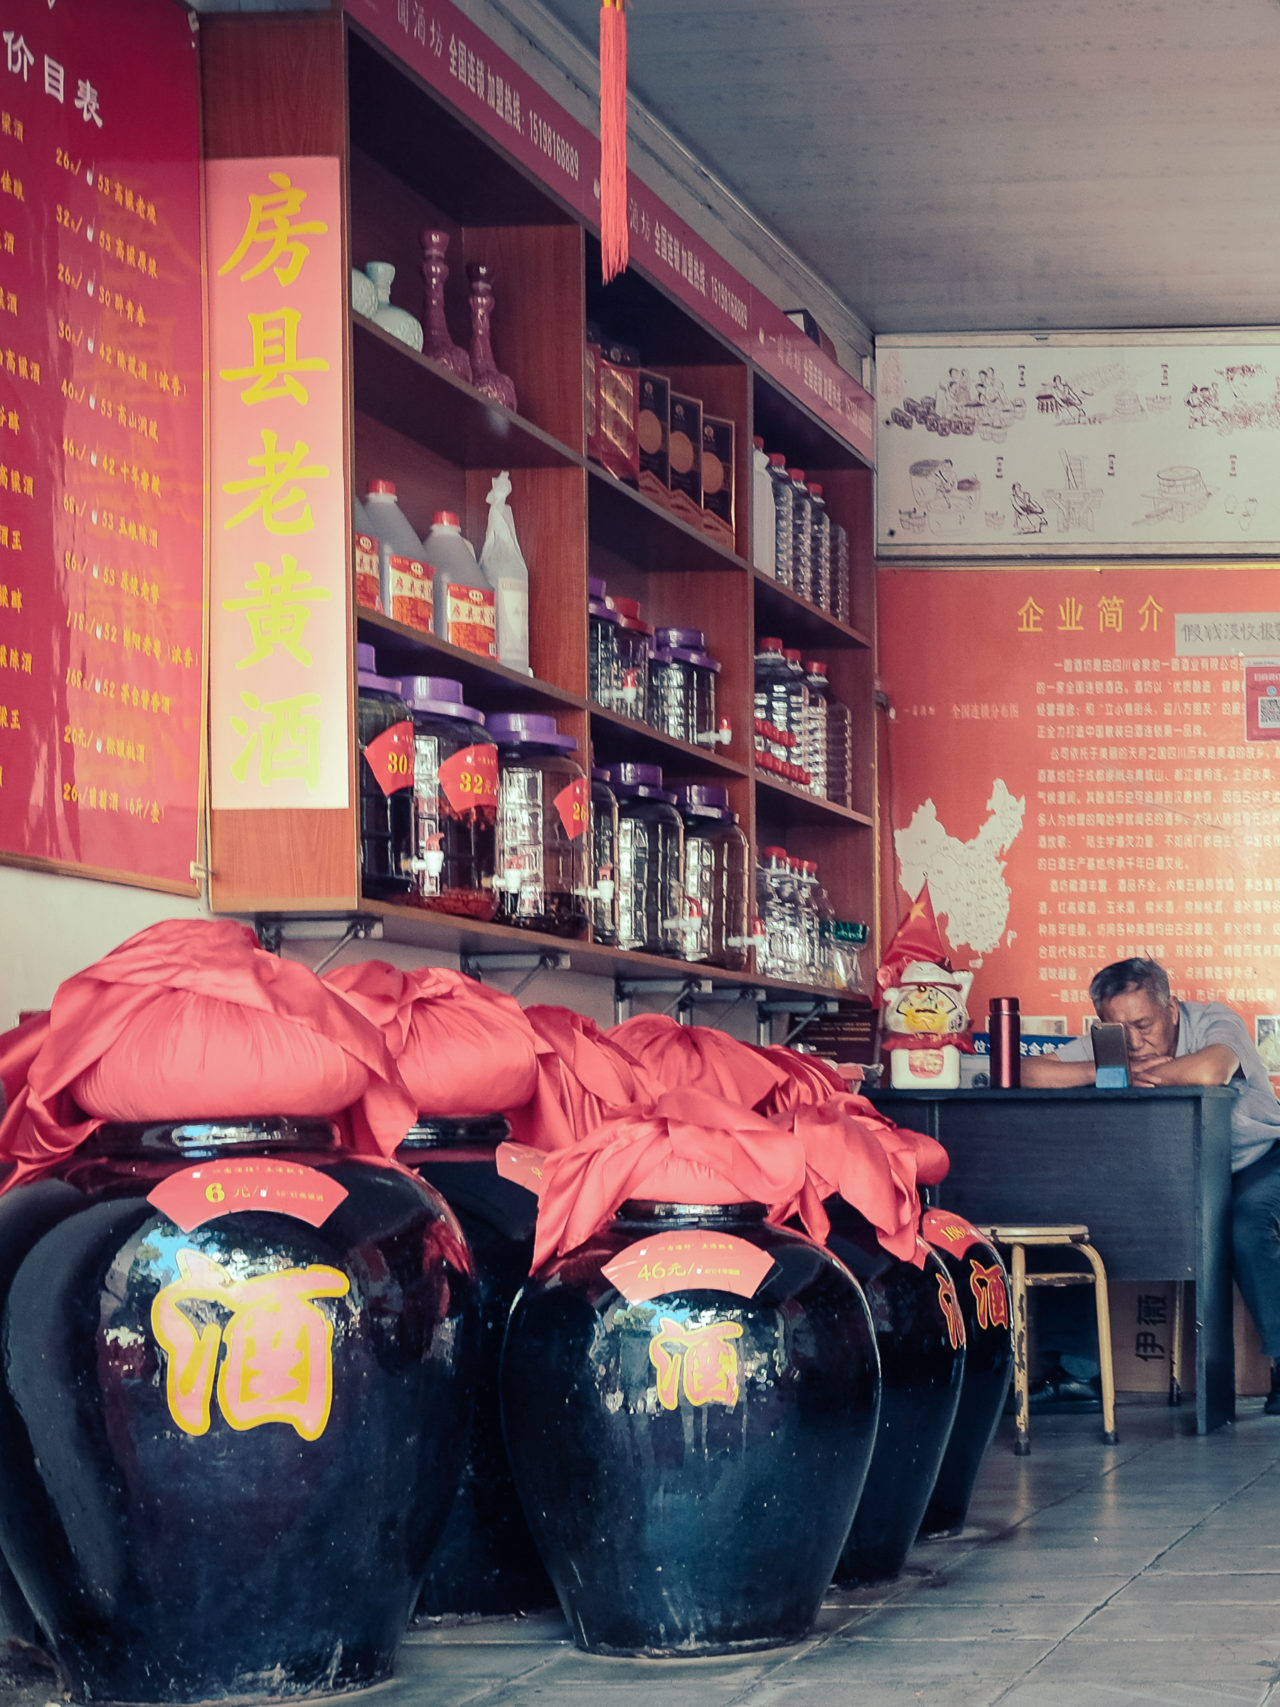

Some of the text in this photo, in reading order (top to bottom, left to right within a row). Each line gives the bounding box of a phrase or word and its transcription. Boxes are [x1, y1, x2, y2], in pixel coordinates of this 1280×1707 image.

[3, 31, 103, 128] 价目表
[449, 34, 484, 101] 全国连锁
[529, 109, 579, 181] 15198168889
[217, 172, 332, 791] 房县老黄酒
[1017, 595, 1164, 634] 企业简介
[151, 1247, 350, 1441] 酒
[649, 1316, 744, 1411] 酒
